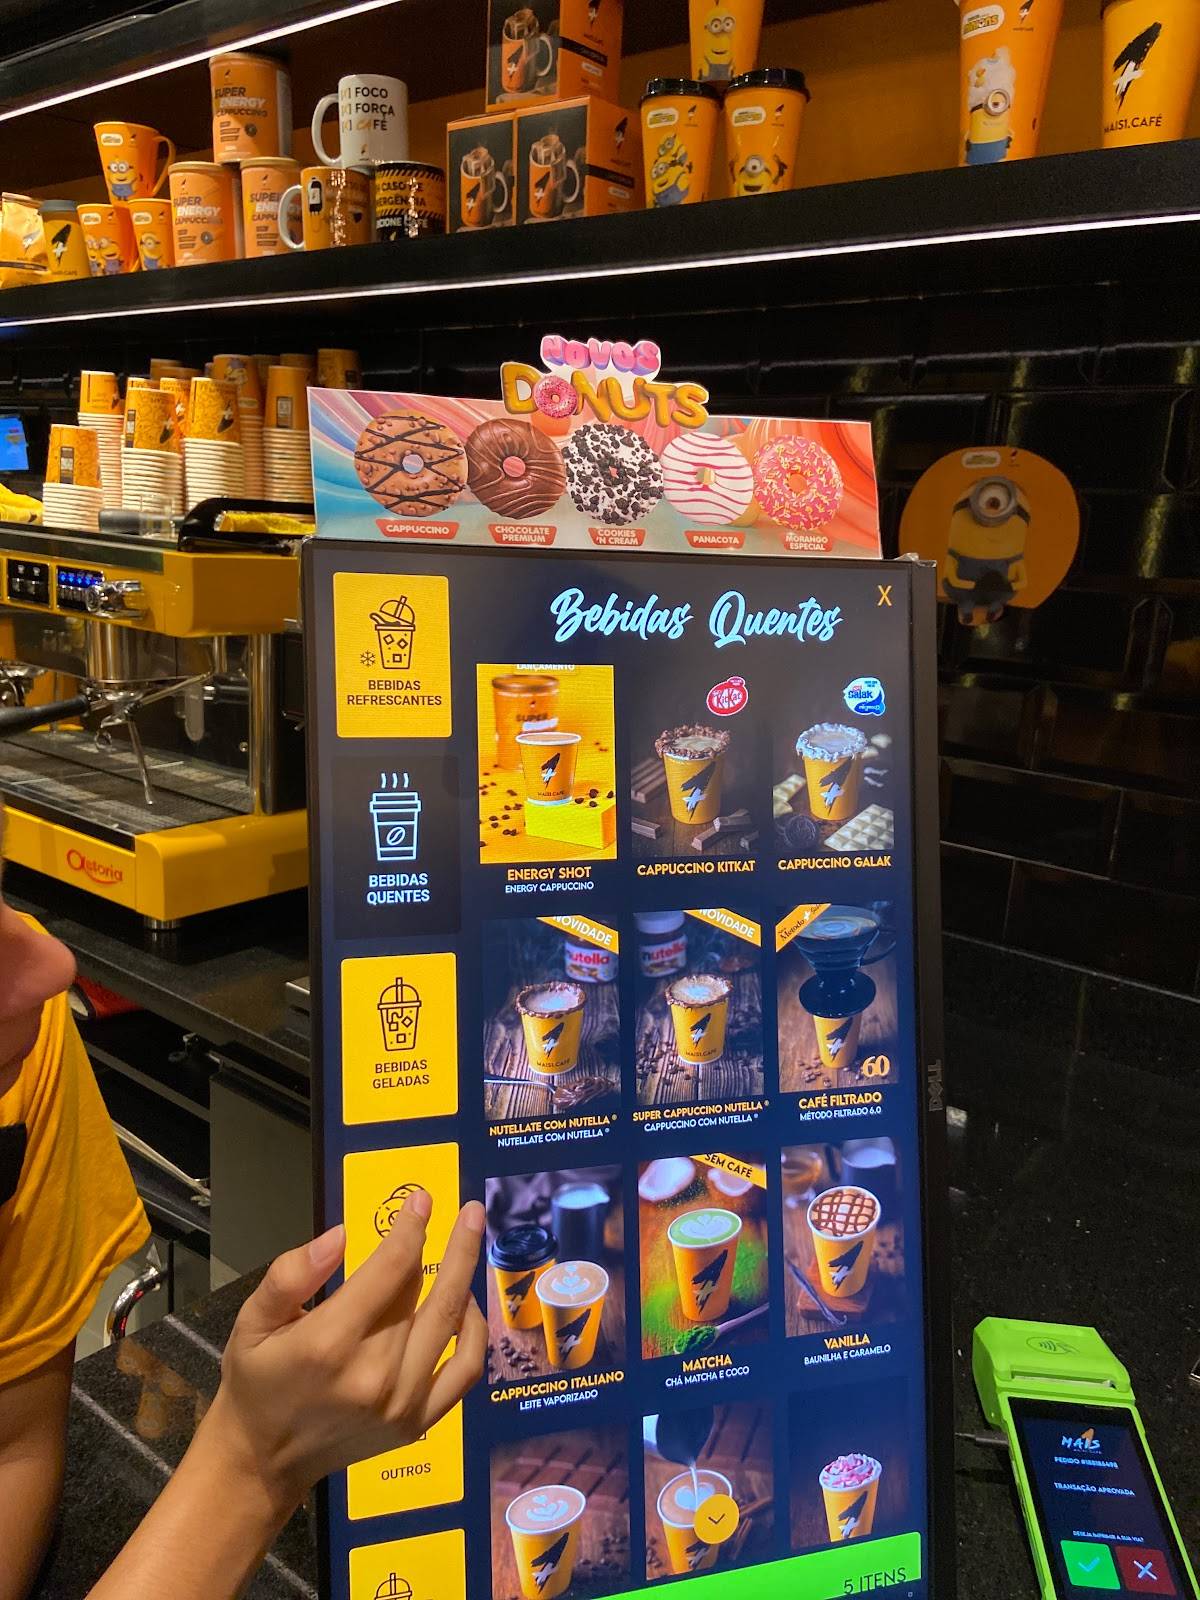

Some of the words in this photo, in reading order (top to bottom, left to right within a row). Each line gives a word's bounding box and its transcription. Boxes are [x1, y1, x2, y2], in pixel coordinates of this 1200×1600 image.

[355, 87, 388, 98] FOCO
[355, 103, 395, 119] FORÇA
[541, 335, 660, 376] NOVOS
[386, 524, 450, 534] CAPPUCCINO
[495, 526, 550, 535] CHOCOLATE
[597, 529, 636, 538] COOKIES
[502, 534, 546, 543] PREMIUM
[609, 537, 639, 545] CREAM
[693, 535, 739, 545] PANACOTA
[785, 535, 829, 543] MORANGO
[789, 542, 825, 550] ESPECIAL
[550, 588, 694, 643] Bebidas
[709, 591, 843, 649] Quentes
[368, 680, 420, 691] BEBIDAS
[347, 695, 442, 706] REFRESCANTES
[637, 862, 715, 876] CAPPUCCINO
[717, 860, 756, 873] KITKAT
[777, 857, 852, 870] CAPPUCCINO
[854, 855, 891, 868] GALAK
[369, 873, 428, 887] BEBIDAS
[507, 868, 555, 880] ENERGY
[558, 866, 592, 879] SHOT
[505, 884, 538, 893] ENERGY
[540, 881, 594, 892] CAPPUCCINO
[367, 889, 430, 905] QUENTES
[375, 1059, 428, 1074] BEBIDAS
[372, 1074, 430, 1089] GELADAS
[799, 1093, 828, 1109] CAFÉ
[830, 1092, 882, 1107] FILTRADO
[632, 1110, 662, 1121] SUPER
[663, 1104, 723, 1119] CAPPUCCINO
[724, 1101, 763, 1113] NUTELLA
[800, 1109, 832, 1121] MÉTODO
[834, 1106, 868, 1118] FILTRADO
[870, 1105, 882, 1115] 6.0
[489, 1121, 542, 1136] NUTELLATE
[544, 1120, 567, 1130] COM
[569, 1115, 611, 1128] NUTELLA
[644, 1118, 697, 1132] CAPPUCCINO
[698, 1117, 718, 1127] COM
[719, 1114, 753, 1125] NUTELLA
[497, 1134, 543, 1148] NUTELLATE
[544, 1132, 566, 1143] COM
[567, 1129, 603, 1141] NUTELLA
[705, 1153, 726, 1167] SEM
[727, 1162, 753, 1178] CAFÉ
[824, 1333, 871, 1350] VANILLA
[804, 1351, 842, 1366] BAUNILHA
[843, 1350, 848, 1359] E
[849, 1344, 891, 1358] CARAMELO
[682, 1354, 733, 1373] MATCHA
[665, 1375, 683, 1388] CHÁ
[684, 1372, 718, 1386] MATCHA
[719, 1370, 725, 1380] E
[725, 1366, 750, 1378] COCO
[491, 1379, 568, 1402] CAPPUCCINO
[570, 1370, 625, 1390] ITALIANO
[519, 1397, 542, 1411] LEITE
[543, 1389, 599, 1408] VAPORIZADO
[381, 1462, 431, 1481] OUTROS
[1054, 1482, 1097, 1493] TRANSAÇÃO
[1098, 1487, 1136, 1496] APROVADA
[844, 1578, 854, 1594] 5
[860, 1567, 906, 1592] ITENS
